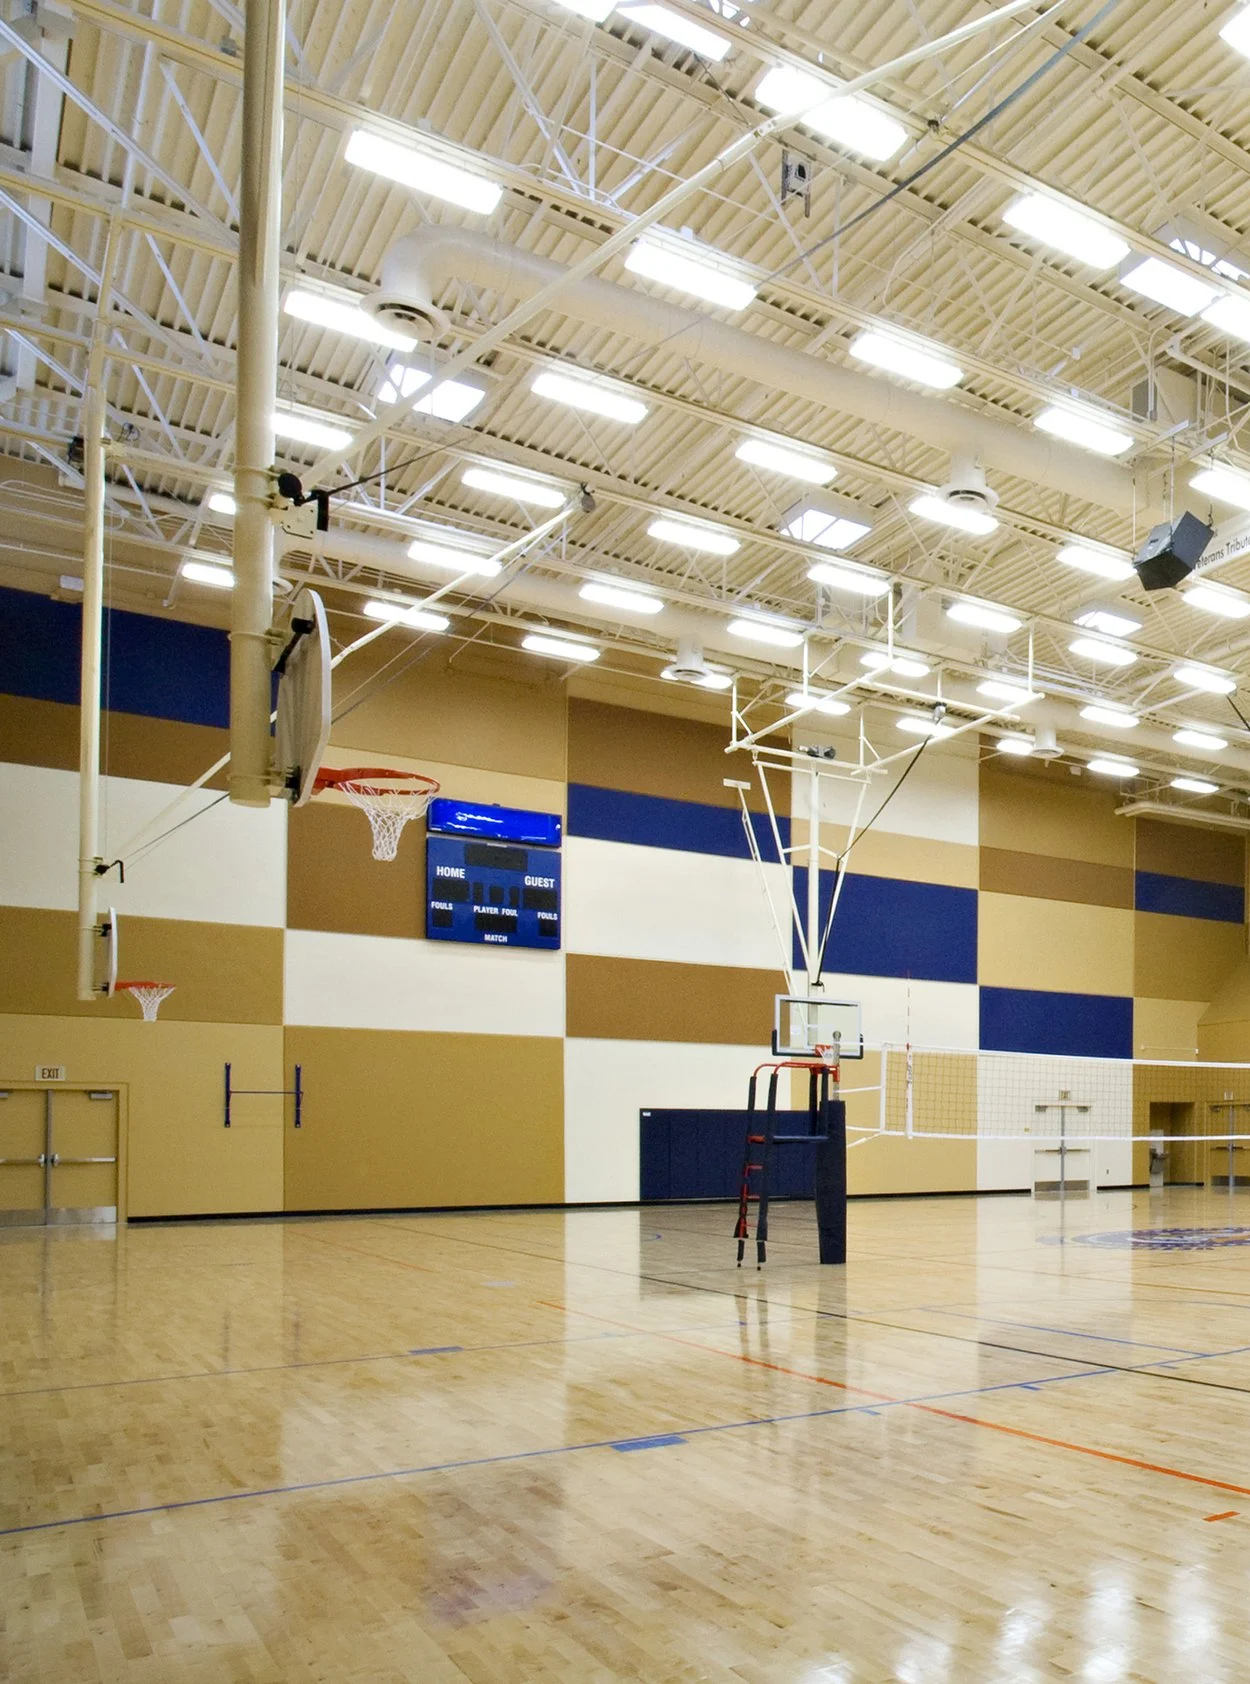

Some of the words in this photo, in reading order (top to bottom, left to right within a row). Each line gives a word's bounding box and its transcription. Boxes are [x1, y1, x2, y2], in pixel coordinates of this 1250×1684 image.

[1195, 548, 1224, 570] eterans
[436, 866, 465, 879] HOME
[524, 876, 555, 888] GUEST
[431, 901, 453, 910] FOULS
[474, 905, 498, 915] PLAYER
[502, 907, 518, 917] FOUL
[537, 911, 558, 921] FOULS
[484, 934, 508, 943] MATCH
[41, 1068, 59, 1079] EXIT
